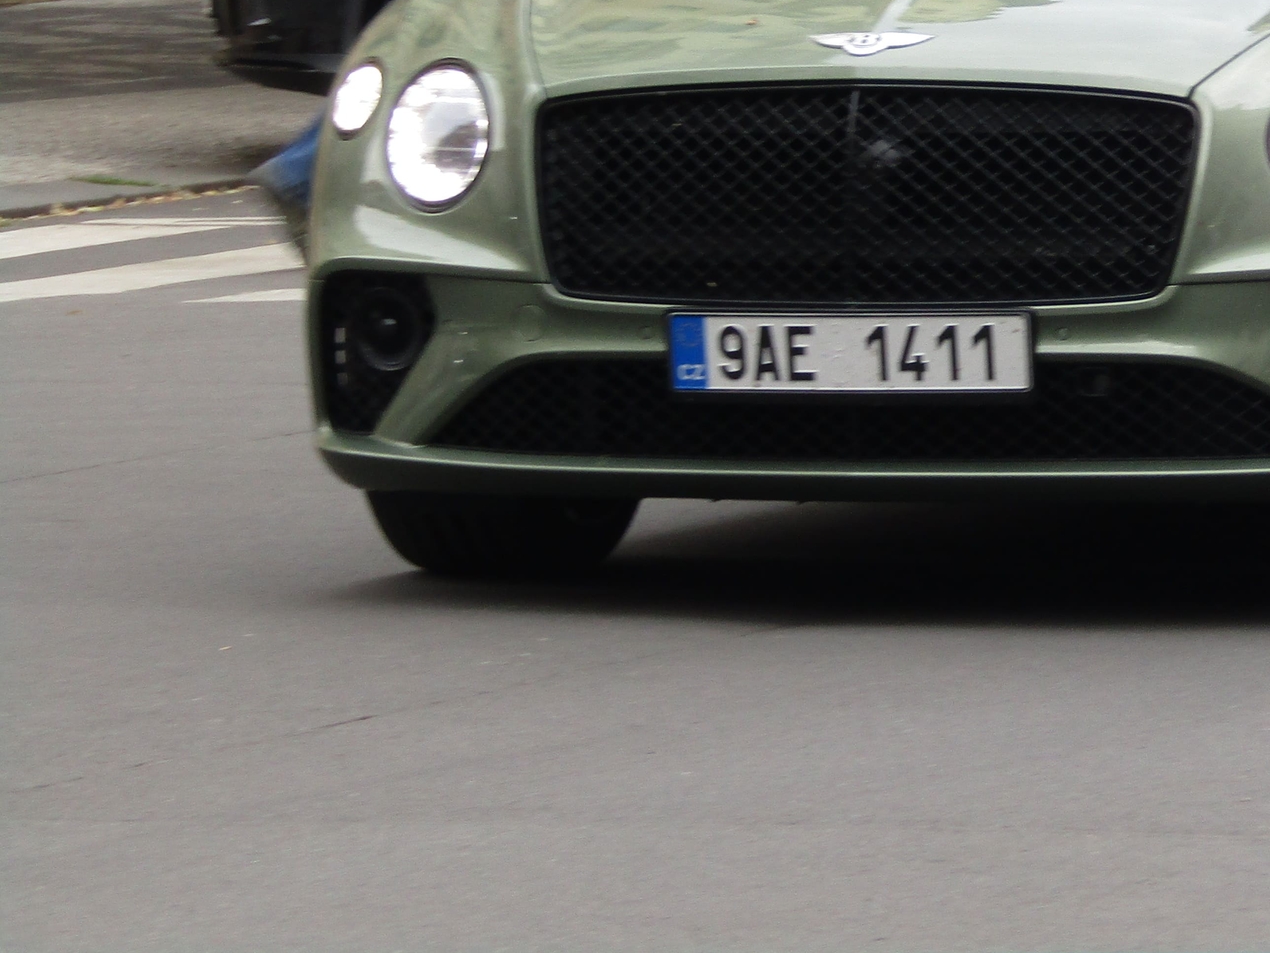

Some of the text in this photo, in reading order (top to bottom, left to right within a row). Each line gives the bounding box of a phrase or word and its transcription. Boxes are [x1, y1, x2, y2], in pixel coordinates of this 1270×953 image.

[718, 324, 997, 381] 9AE 1411
[677, 364, 706, 380] CZ
